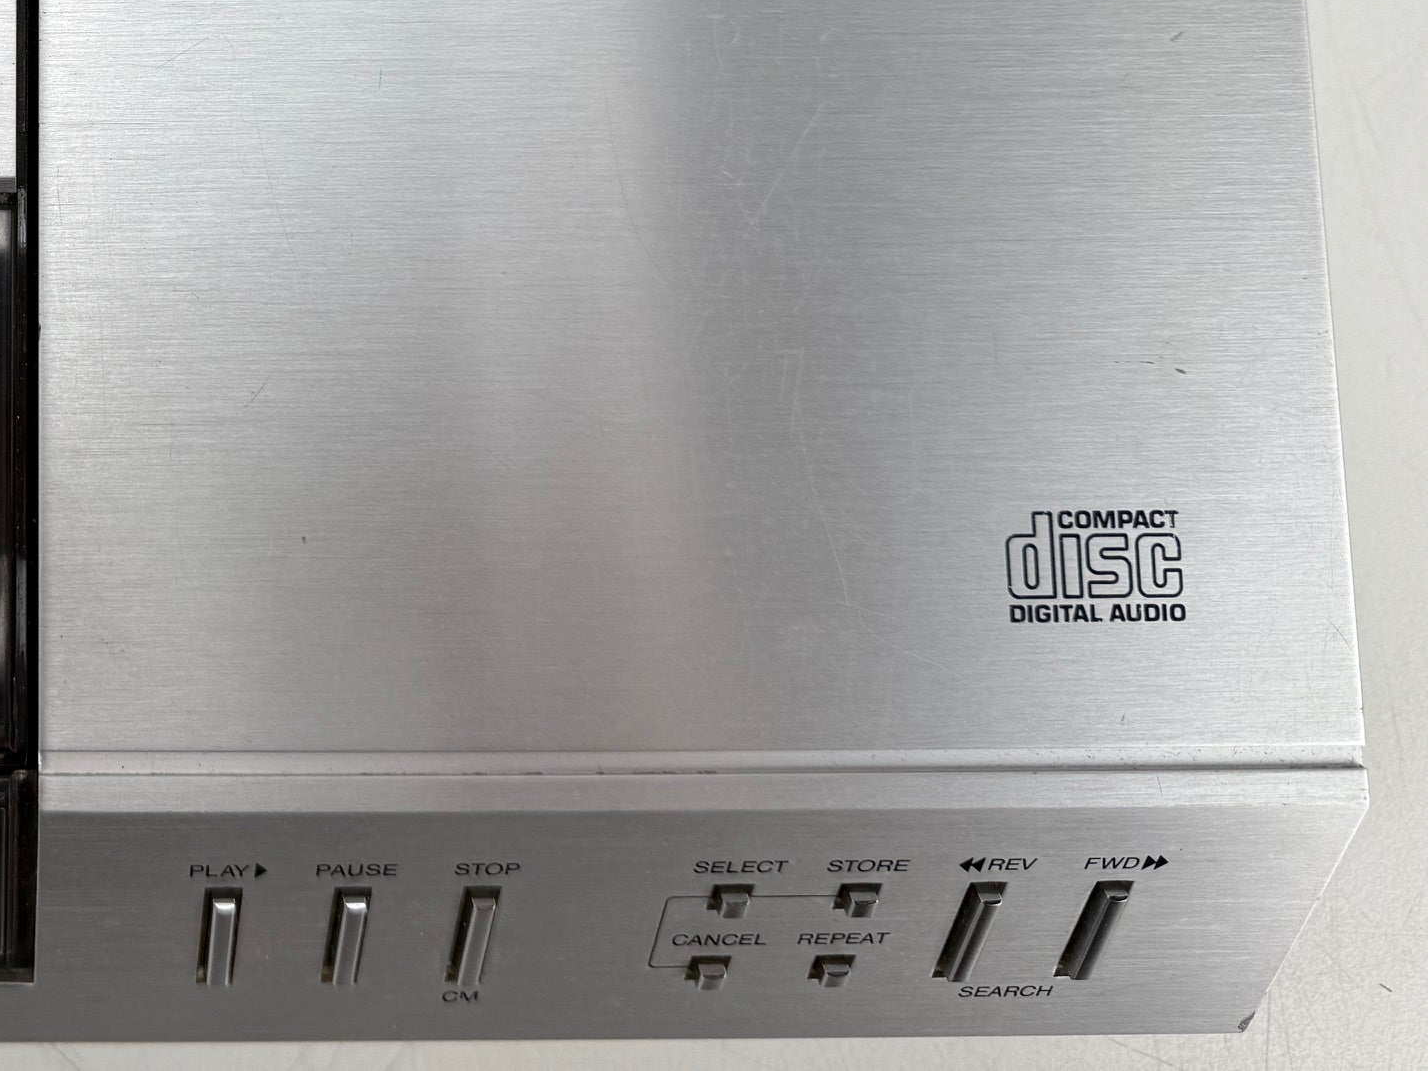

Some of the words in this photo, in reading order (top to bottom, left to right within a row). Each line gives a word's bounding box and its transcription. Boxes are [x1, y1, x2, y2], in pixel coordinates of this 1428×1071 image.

[1057, 510, 1179, 529] COMPACT
[1009, 604, 1102, 623] DIGITAL
[1109, 603, 1186, 622] AUDIO
[316, 863, 398, 877] PAUSE
[454, 862, 522, 876] STOP
[693, 860, 789, 873] SELECT
[827, 859, 910, 872] STORE
[987, 858, 1038, 871] REV
[1084, 857, 1140, 870] FWD
[189, 864, 250, 878] PLAY
[672, 932, 767, 946] CANCEL
[797, 932, 891, 945] REPEAT
[442, 990, 479, 1003] CM
[958, 985, 1054, 998] SEARCH
